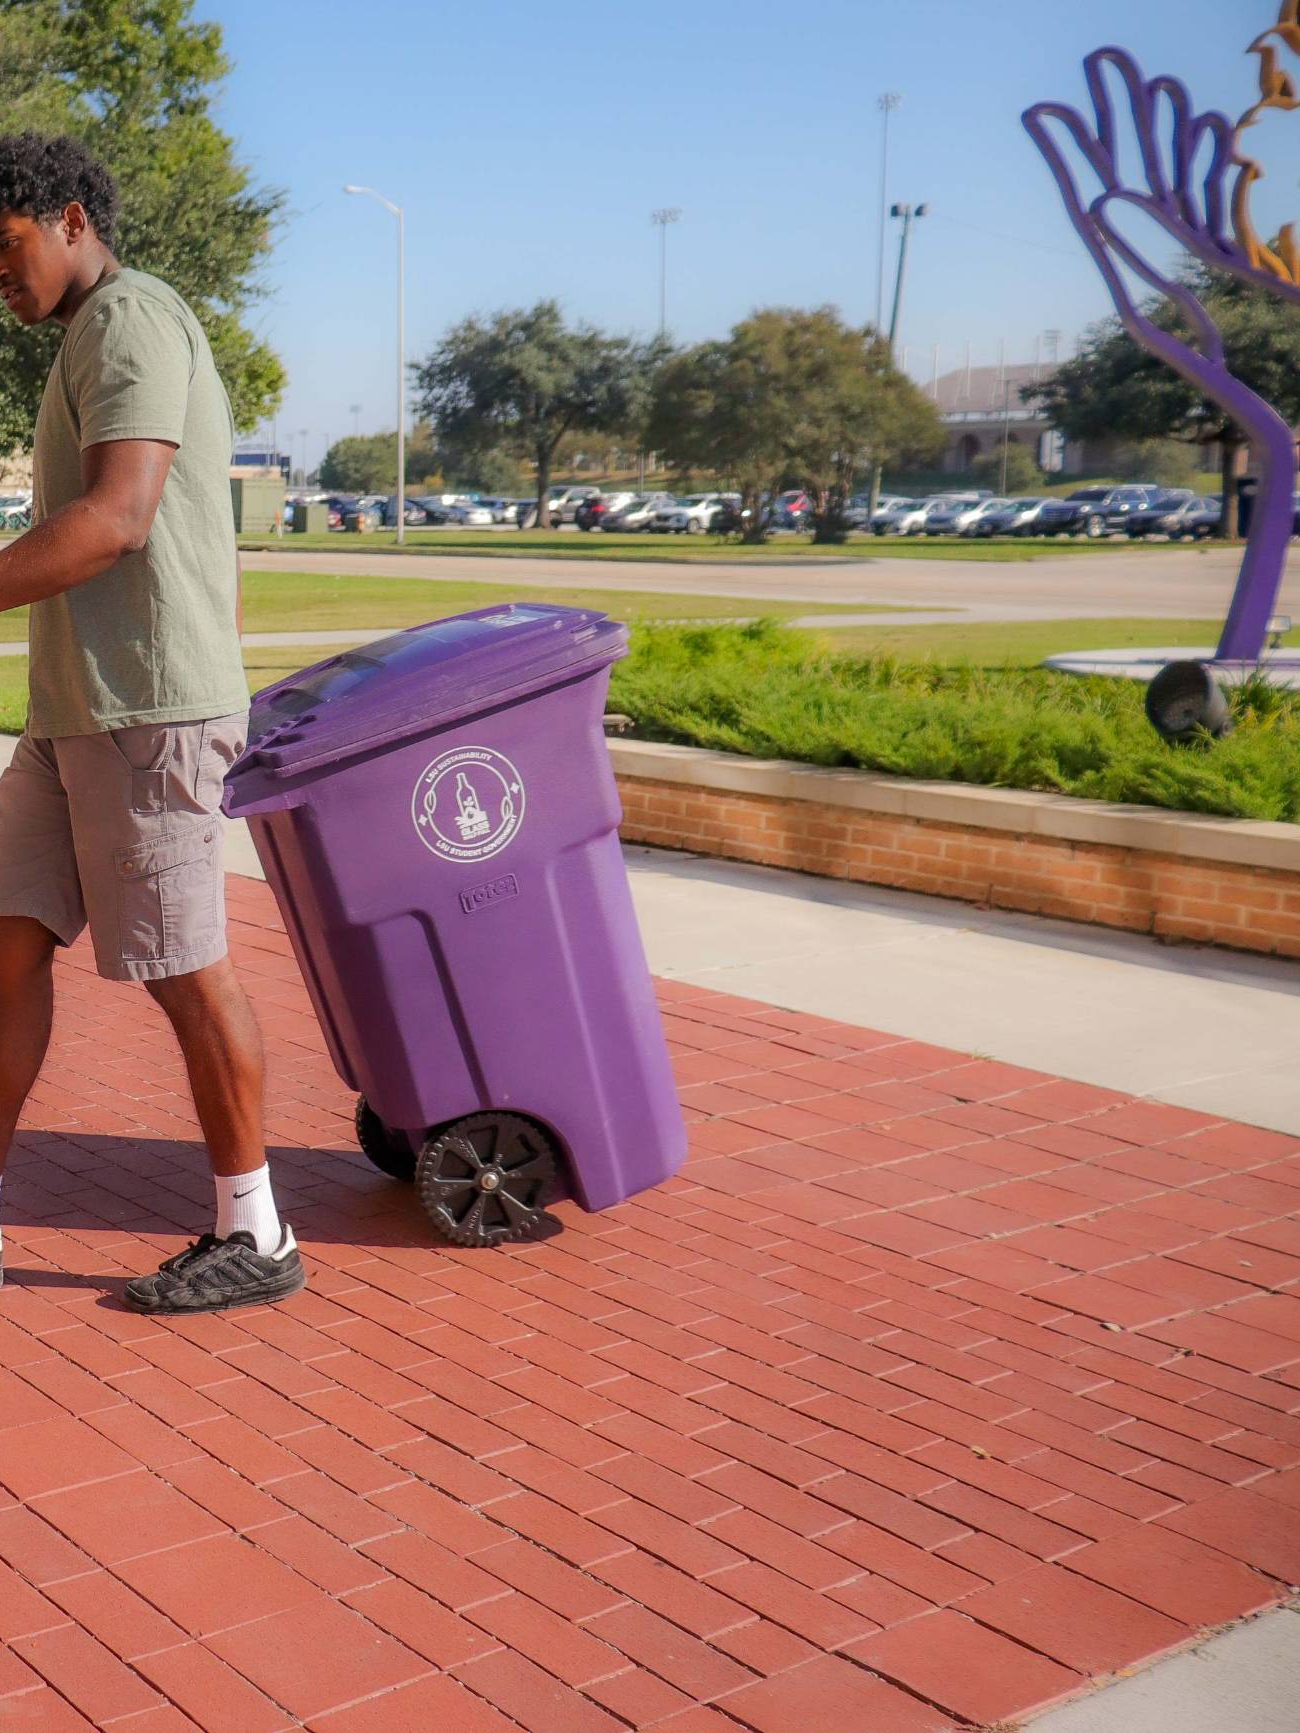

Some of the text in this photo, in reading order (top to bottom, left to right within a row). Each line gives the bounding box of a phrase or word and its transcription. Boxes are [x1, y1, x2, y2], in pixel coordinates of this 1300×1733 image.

[425, 751, 493, 783] LSU SUSTAINABILITY
[436, 839, 450, 852] LSU
[449, 847, 482, 857] STUDENT
